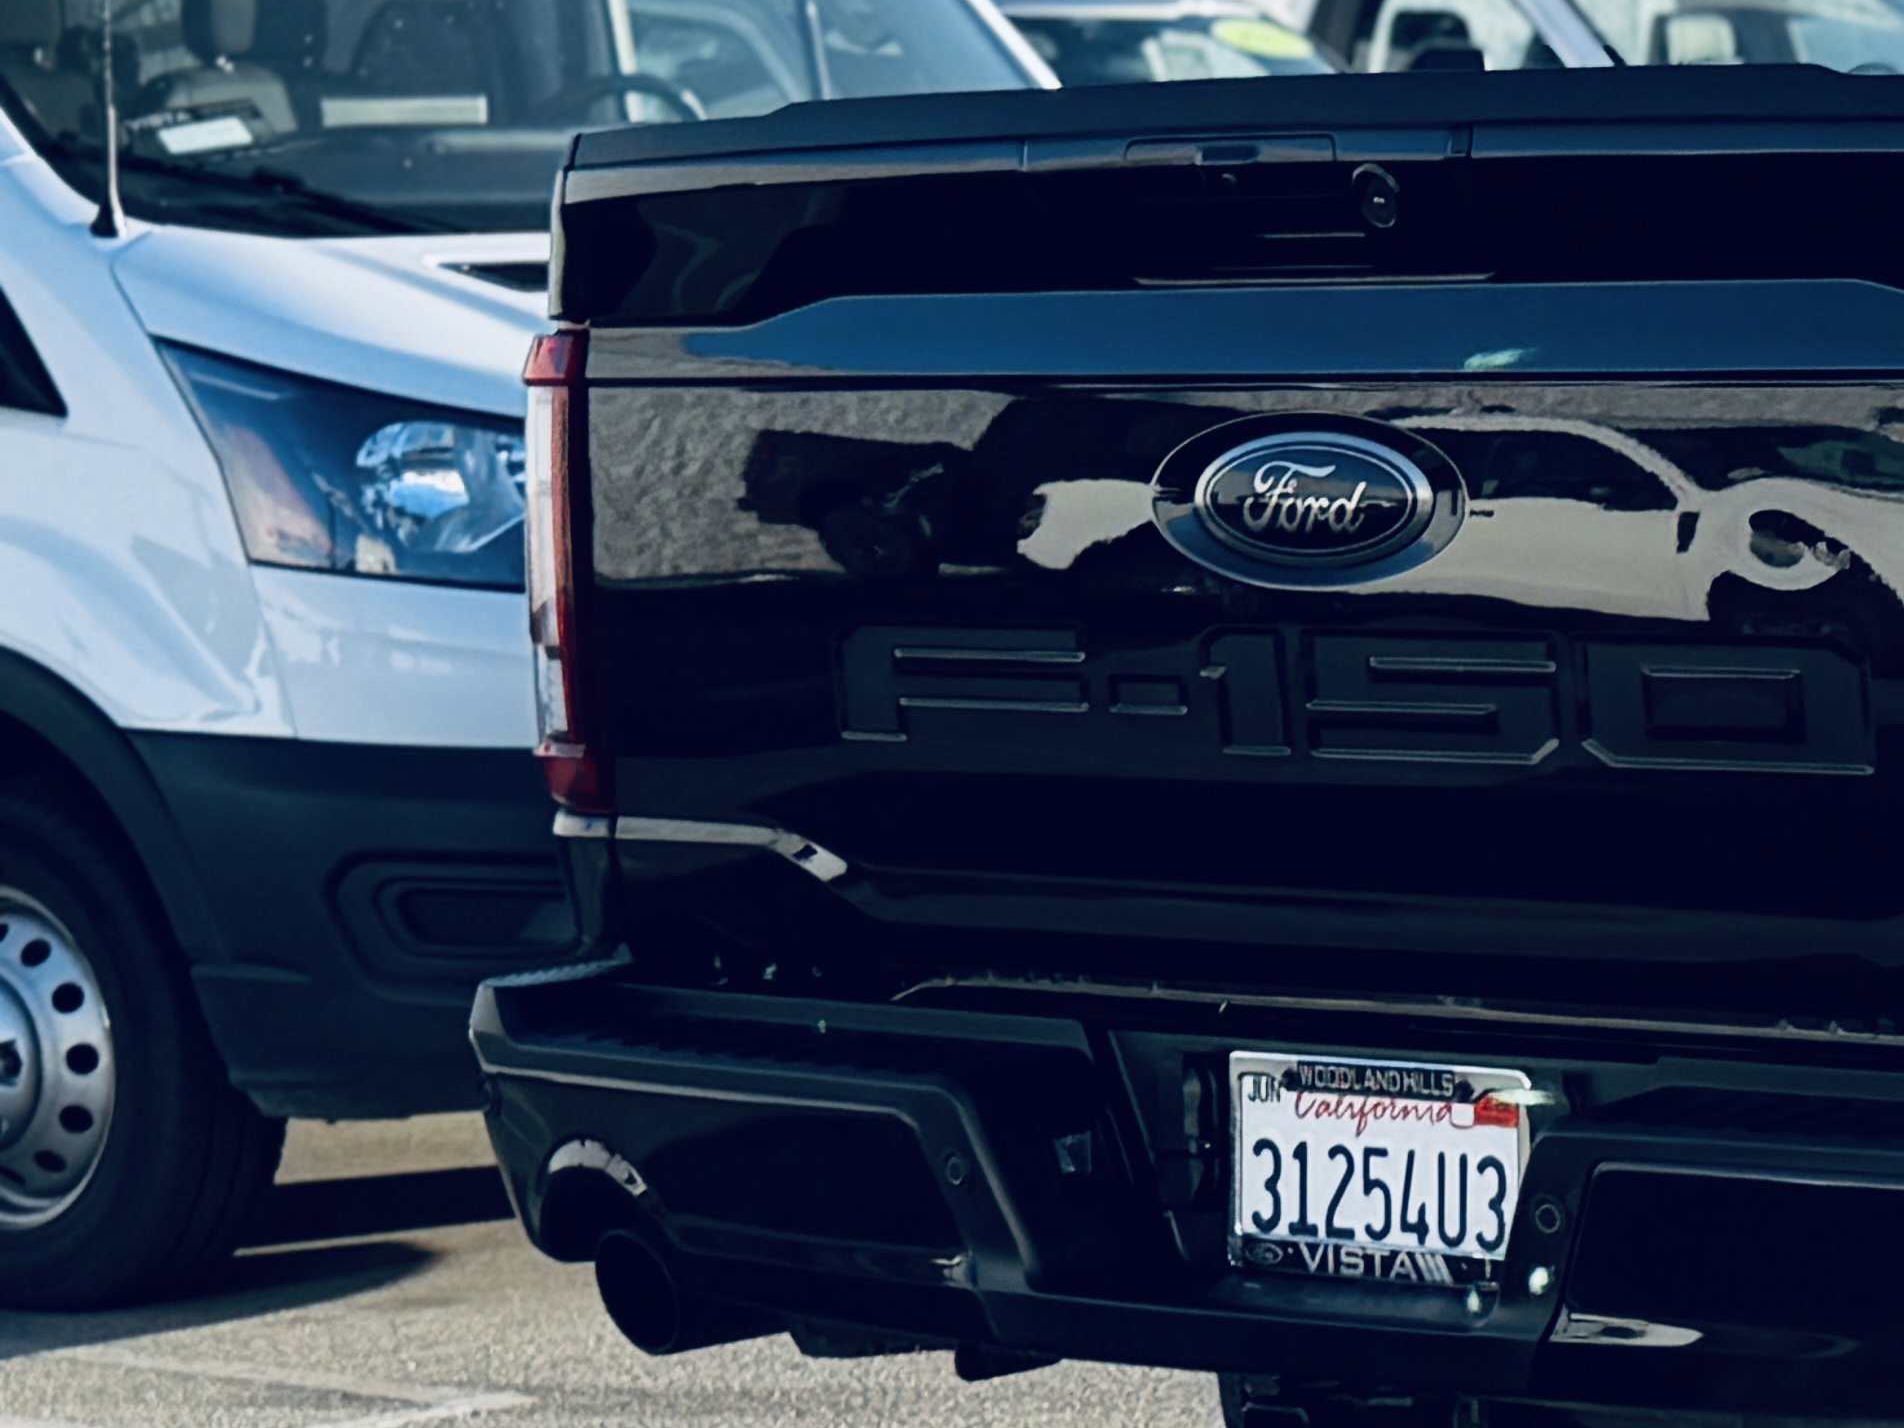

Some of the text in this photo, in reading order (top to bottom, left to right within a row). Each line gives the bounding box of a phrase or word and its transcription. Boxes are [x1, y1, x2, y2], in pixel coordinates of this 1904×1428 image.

[1243, 459, 1367, 534] Ford
[836, 621, 1876, 776] F-150
[1295, 1090, 1474, 1138] California
[1251, 1137, 1508, 1253] 31254U3
[1297, 1241, 1418, 1283] VISTA
